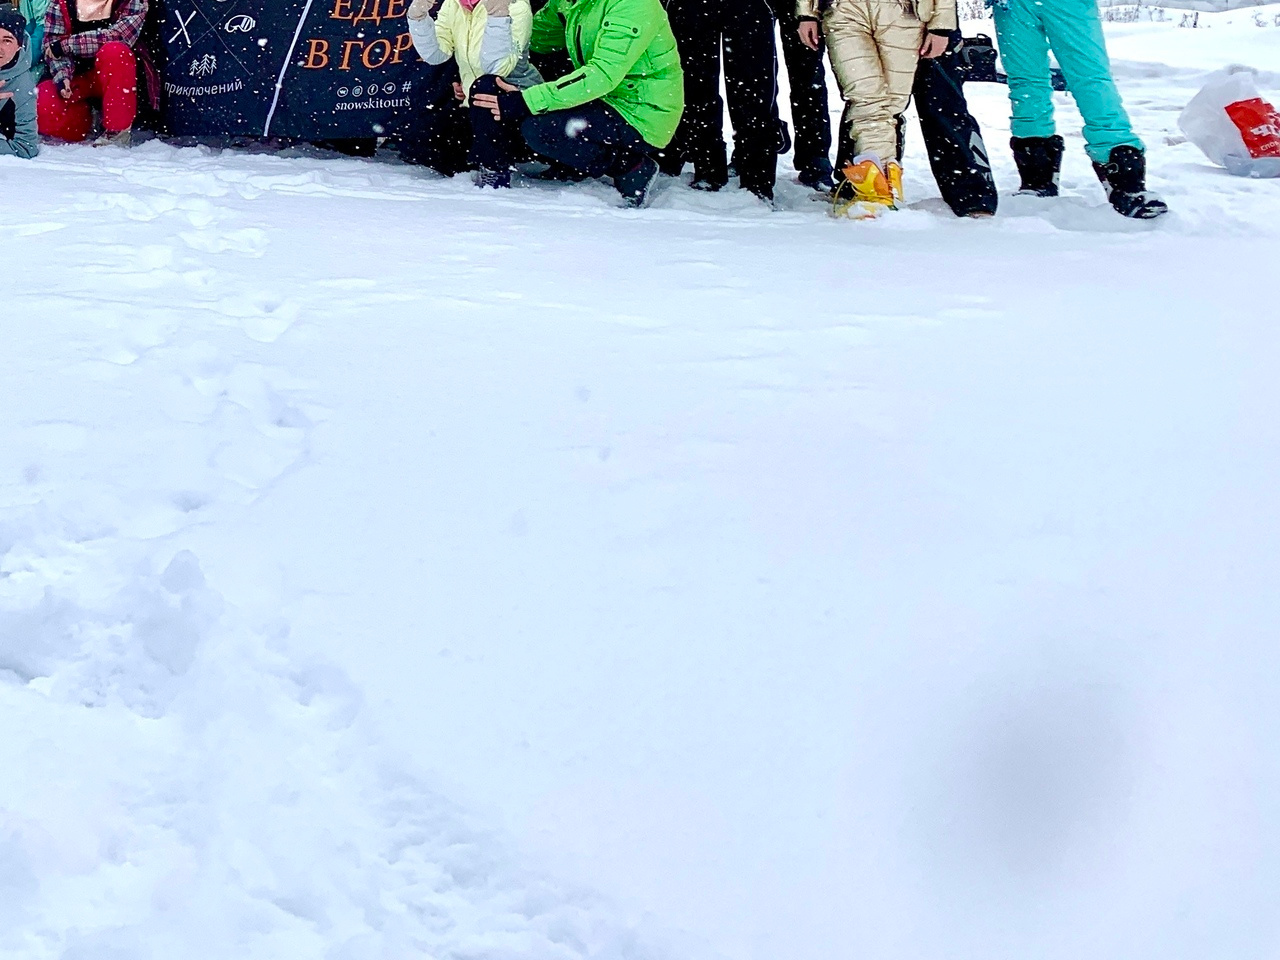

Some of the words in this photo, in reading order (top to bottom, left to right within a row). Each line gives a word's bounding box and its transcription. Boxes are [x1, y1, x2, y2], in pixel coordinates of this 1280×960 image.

[303, 39, 330, 69] В
[338, 32, 425, 71] ГОР
[164, 78, 244, 97] приключений
[335, 96, 411, 111] snowskitours
